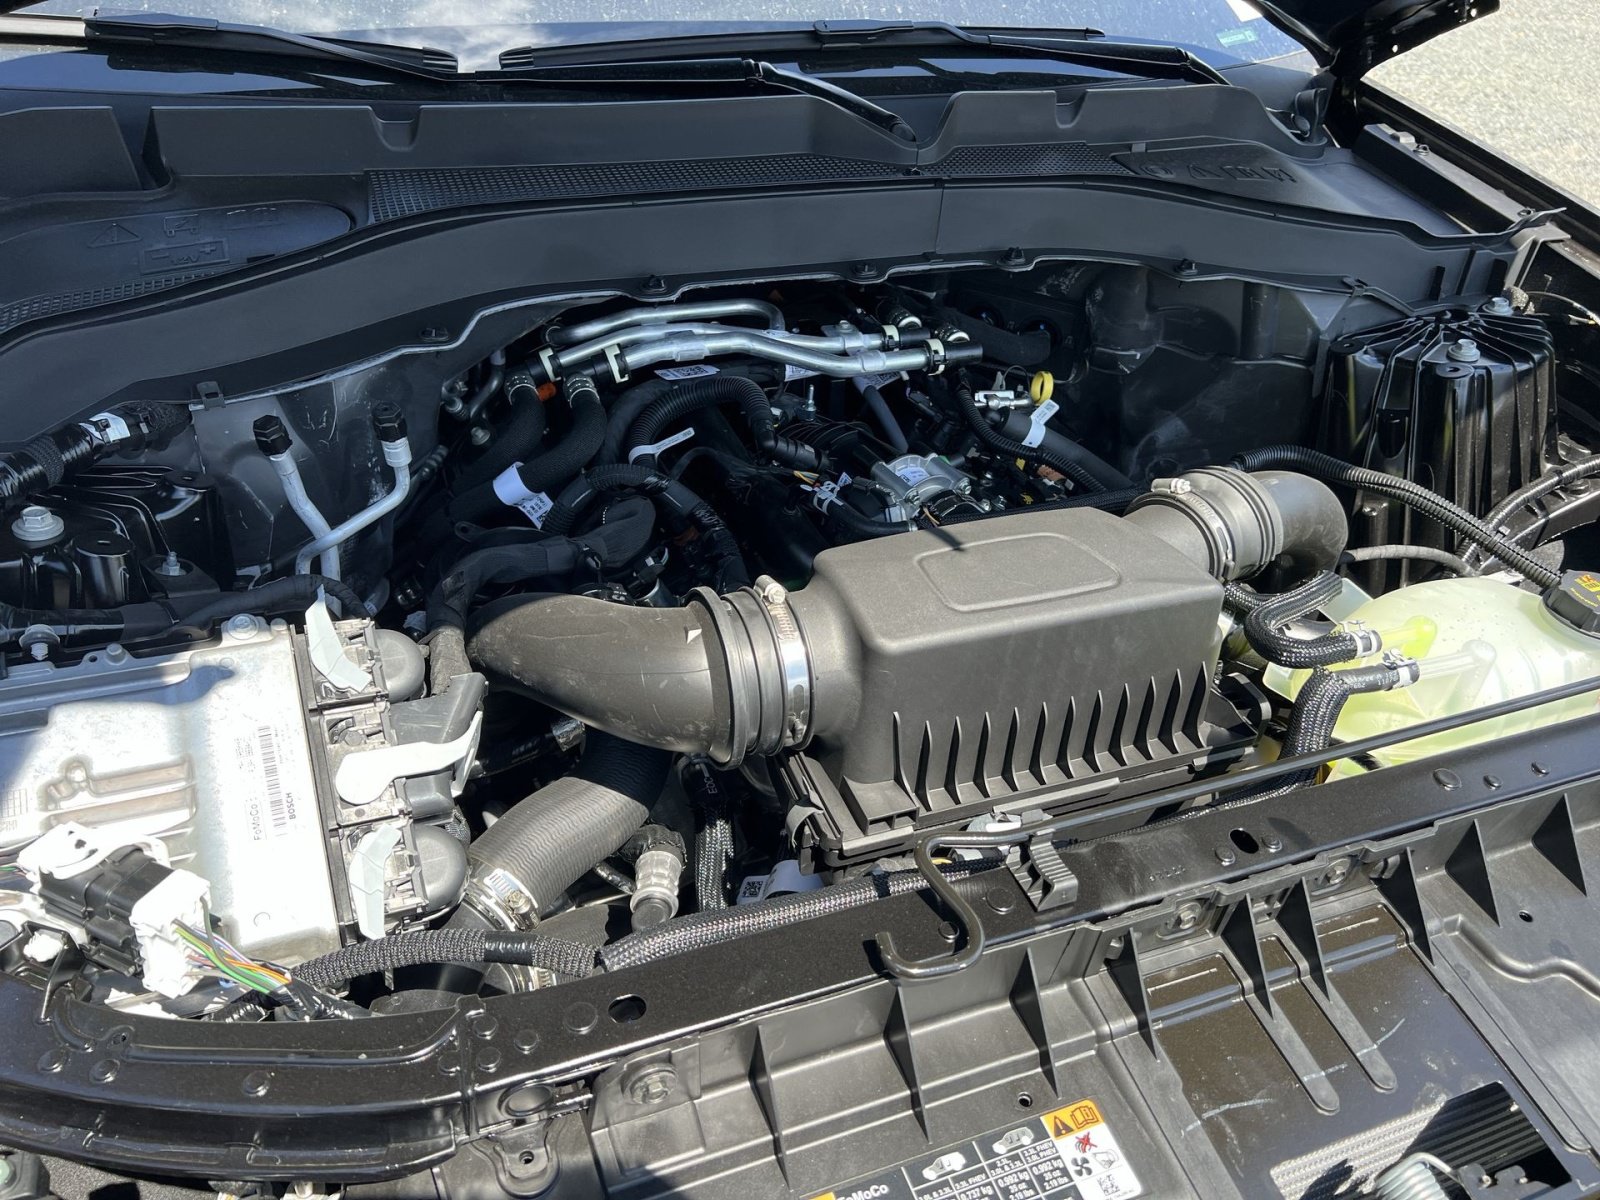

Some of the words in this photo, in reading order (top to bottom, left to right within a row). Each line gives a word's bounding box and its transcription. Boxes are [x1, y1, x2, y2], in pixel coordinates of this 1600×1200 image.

[285, 792, 296, 820] BOSCH
[250, 804, 261, 840] FoMoCo
[1032, 1161, 1053, 1175] 0.992
[1051, 1159, 1064, 1168] kg
[997, 1173, 1019, 1187] 0.992
[1017, 1171, 1030, 1180] kg
[980, 1185, 993, 1195] kg
